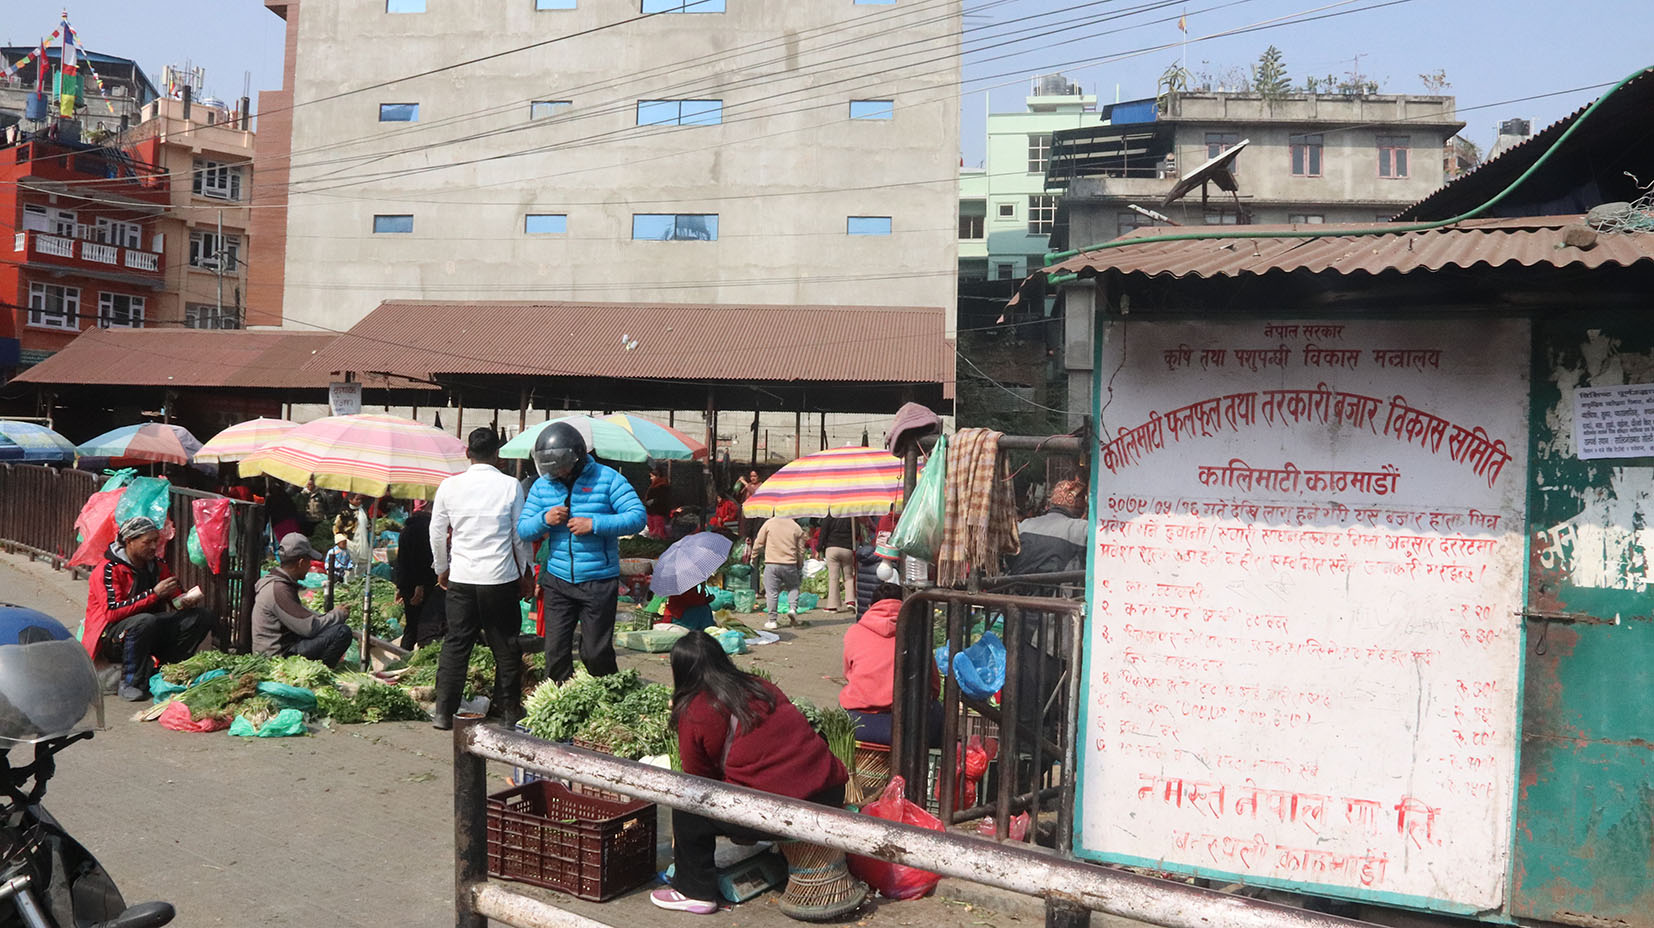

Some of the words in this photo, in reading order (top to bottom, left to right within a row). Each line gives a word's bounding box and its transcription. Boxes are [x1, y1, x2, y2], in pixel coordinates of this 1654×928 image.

[1264, 322, 1298, 340] नेपाल
[1303, 324, 1345, 341] सरकार
[1163, 344, 1193, 371] कृषि
[1200, 349, 1226, 371] तथा
[1303, 344, 1361, 371] विकास
[1101, 410, 1164, 475] कालिमाटी
[1164, 397, 1222, 442] फलफूल
[1222, 392, 1257, 432] तथा
[1262, 381, 1332, 428] तरकारी
[1333, 391, 1383, 435] बजार
[1384, 395, 1450, 455] विकास
[1449, 425, 1512, 489] समिति
[1231, 500, 1259, 522] देखि
[1385, 510, 1426, 529] बजार
[1235, 777, 1333, 835] नेपाल
